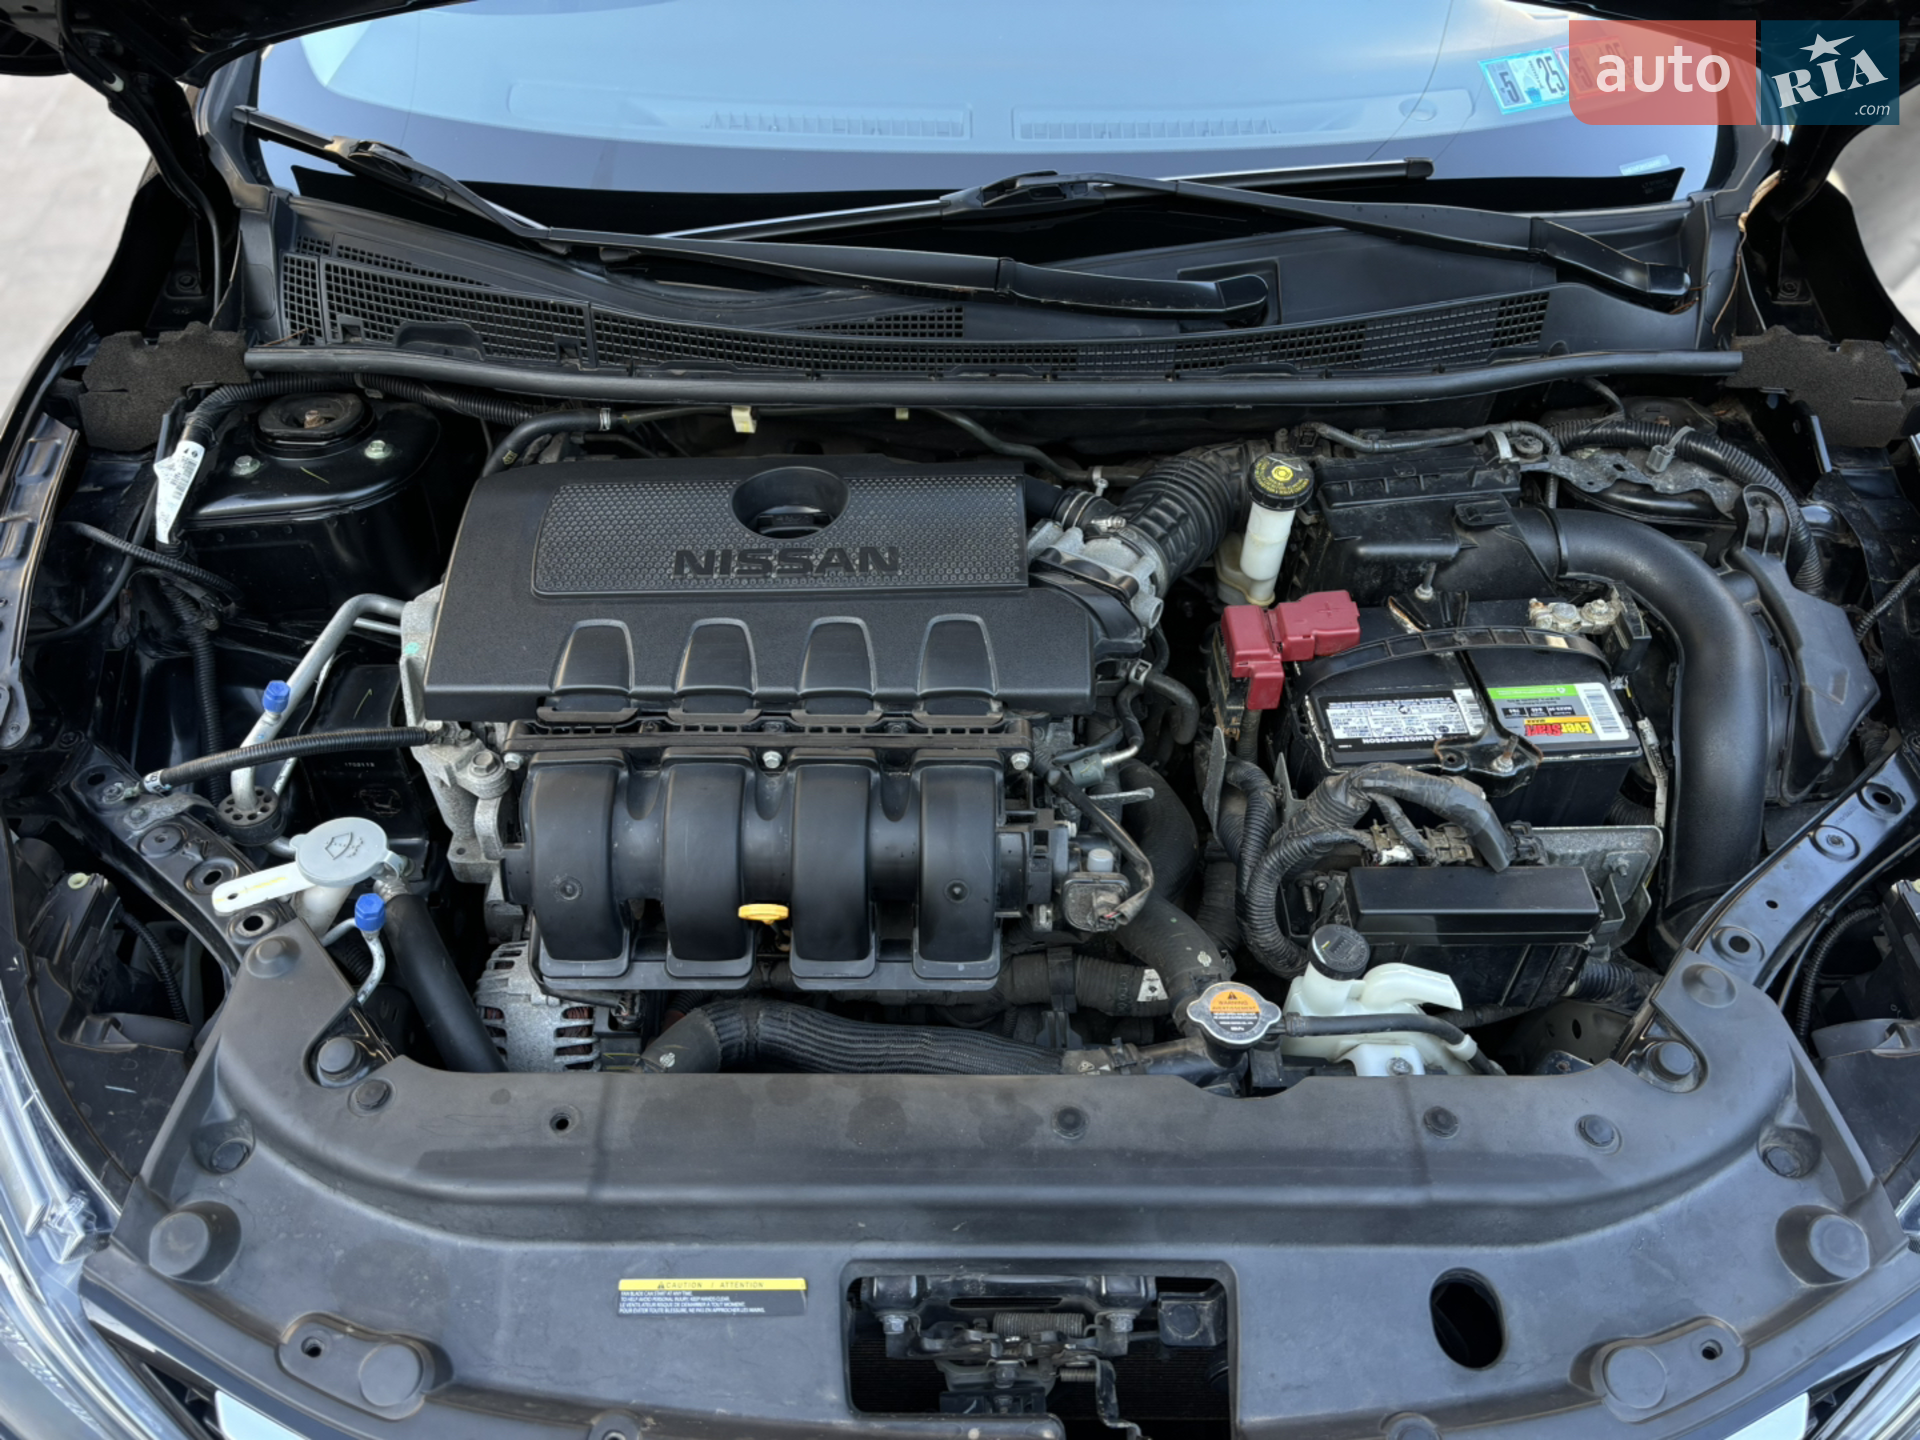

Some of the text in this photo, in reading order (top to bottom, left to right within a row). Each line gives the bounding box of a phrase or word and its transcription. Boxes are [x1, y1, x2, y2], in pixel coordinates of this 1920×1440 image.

[1498, 71, 1521, 104] 5
[1536, 55, 1567, 95] 25
[673, 546, 901, 579] NISSAN
[1523, 722, 1593, 737] EverStart
